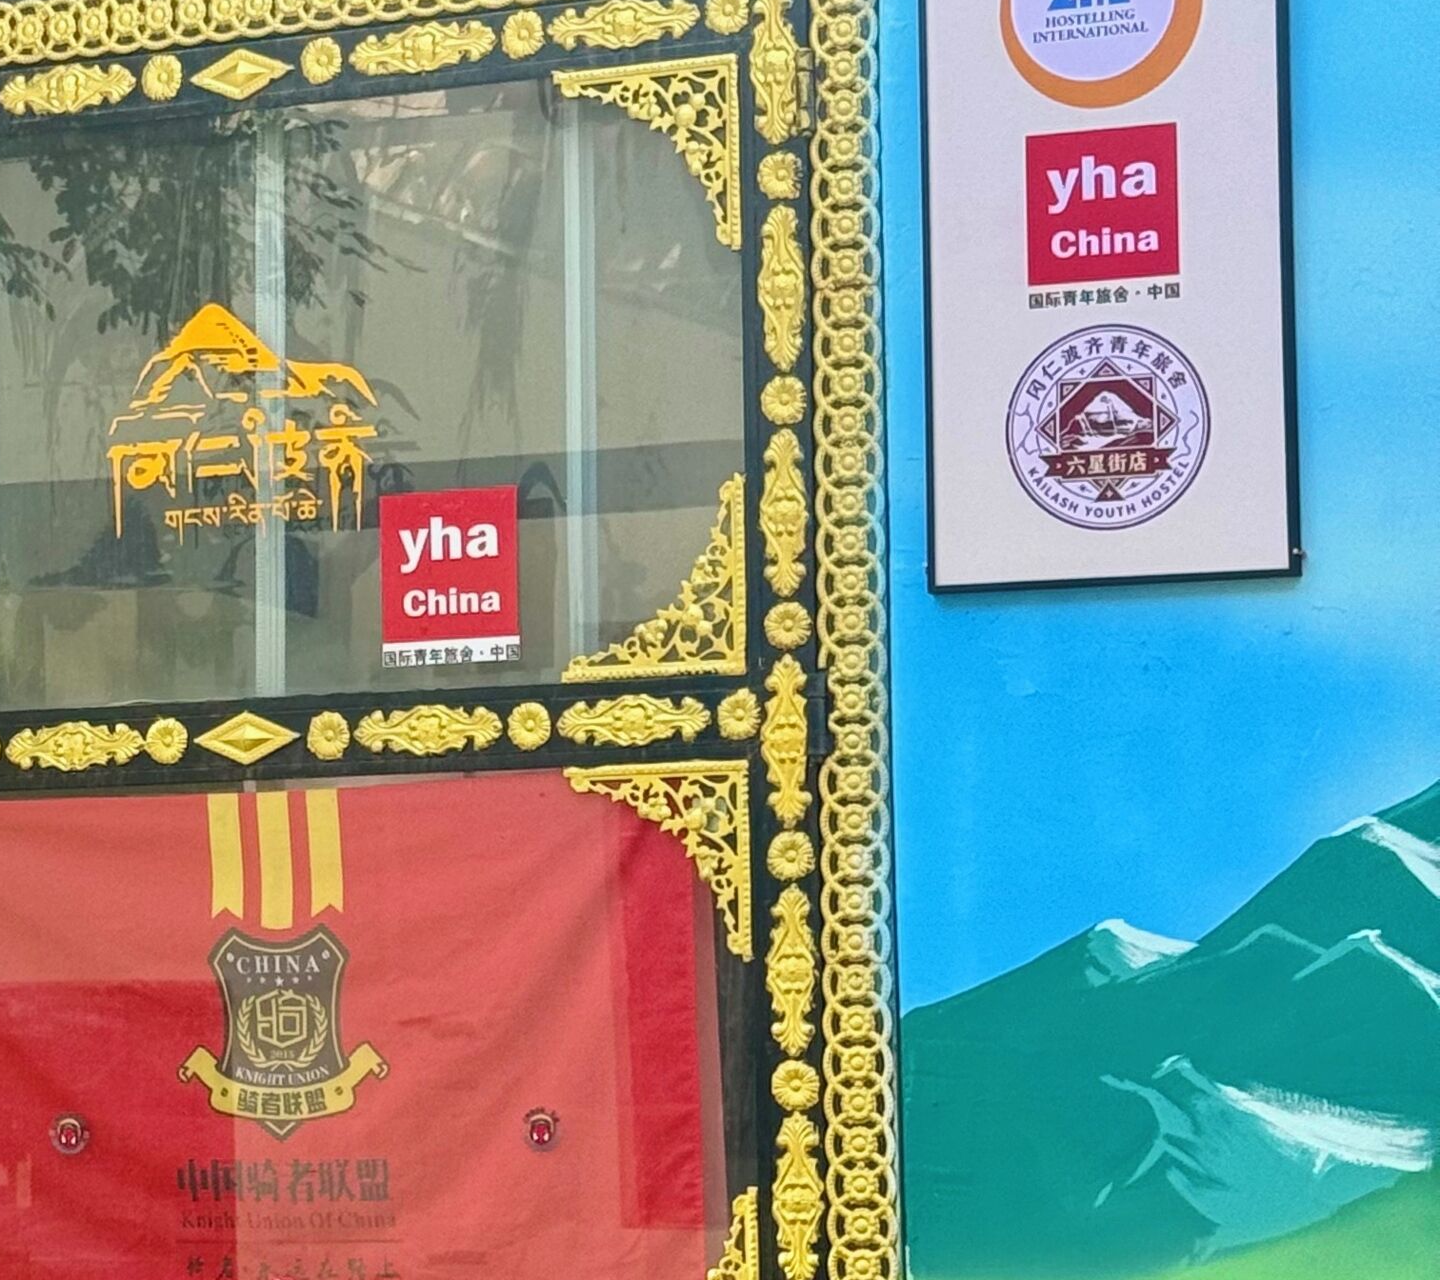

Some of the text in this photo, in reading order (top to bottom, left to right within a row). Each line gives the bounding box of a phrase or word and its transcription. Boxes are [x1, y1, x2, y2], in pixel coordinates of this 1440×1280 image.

[1033, 21, 1149, 44] INTERNATIONAL
[1045, 8, 1136, 28] HOSTELLING
[1046, 155, 1158, 215] yha
[1051, 227, 1160, 259] China
[1066, 451, 1148, 476] 六星街店
[1027, 460, 1190, 519] KAILASH YOUTH HOSTEL
[398, 516, 499, 574] yha
[403, 587, 501, 618] China
[236, 954, 321, 975] CHINA
[235, 1064, 330, 1087] KNIGHT UNION
[236, 1086, 327, 1116] 骑者联盟
